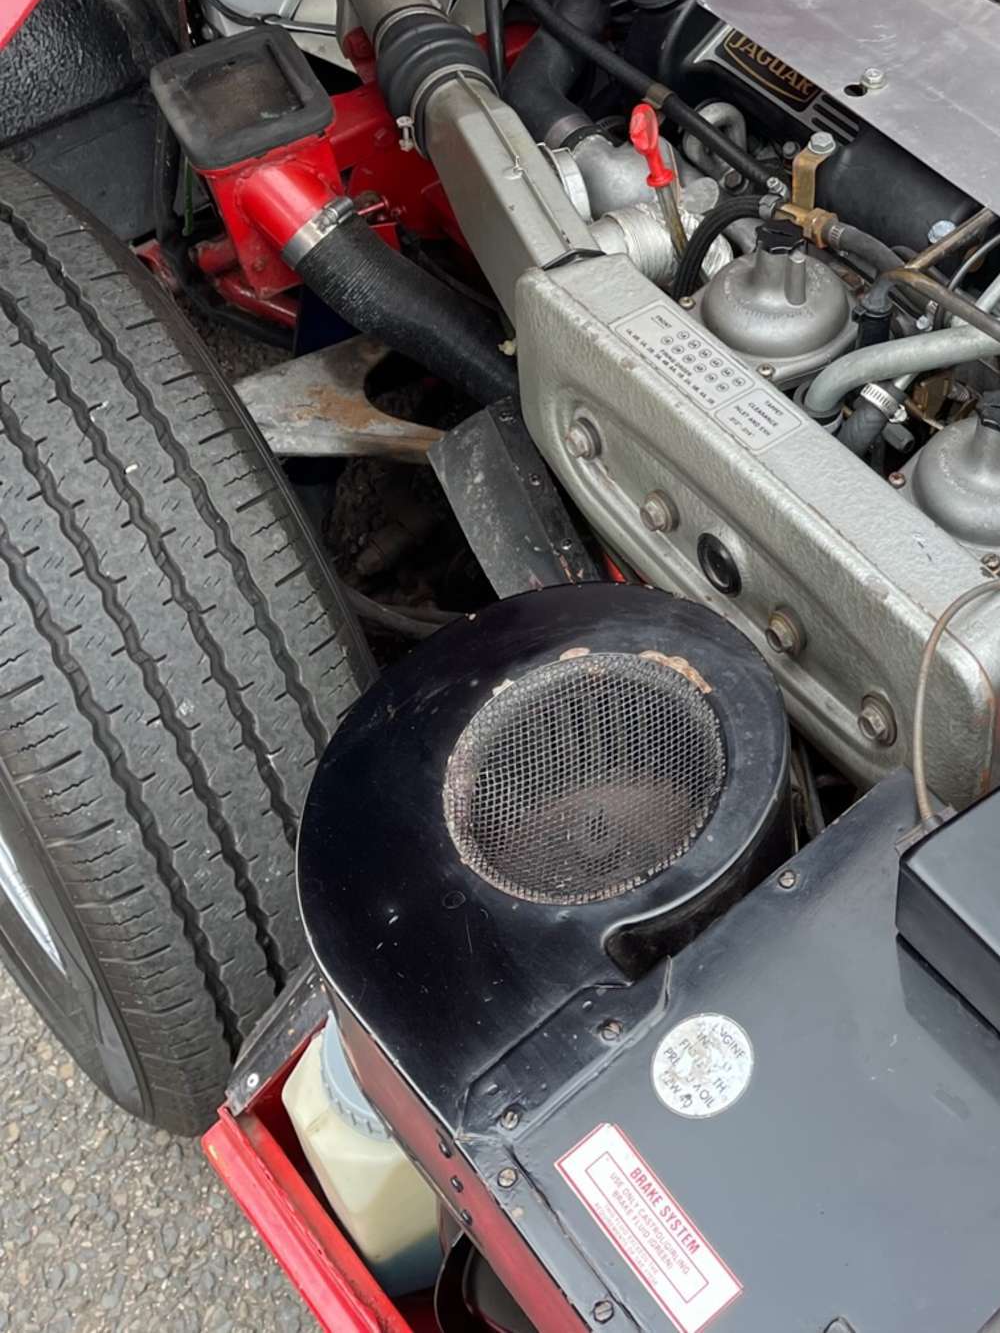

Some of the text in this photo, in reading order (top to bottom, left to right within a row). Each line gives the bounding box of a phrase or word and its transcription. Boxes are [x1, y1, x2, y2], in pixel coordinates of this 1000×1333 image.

[699, 1089, 716, 1108] OIL
[609, 1172, 623, 1187] USE
[621, 1188, 639, 1208] ONLY
[629, 1167, 700, 1254] BRAKE SYSTEM
[611, 1190, 632, 1215] BRAKE
[631, 1215, 650, 1238] FLUID
